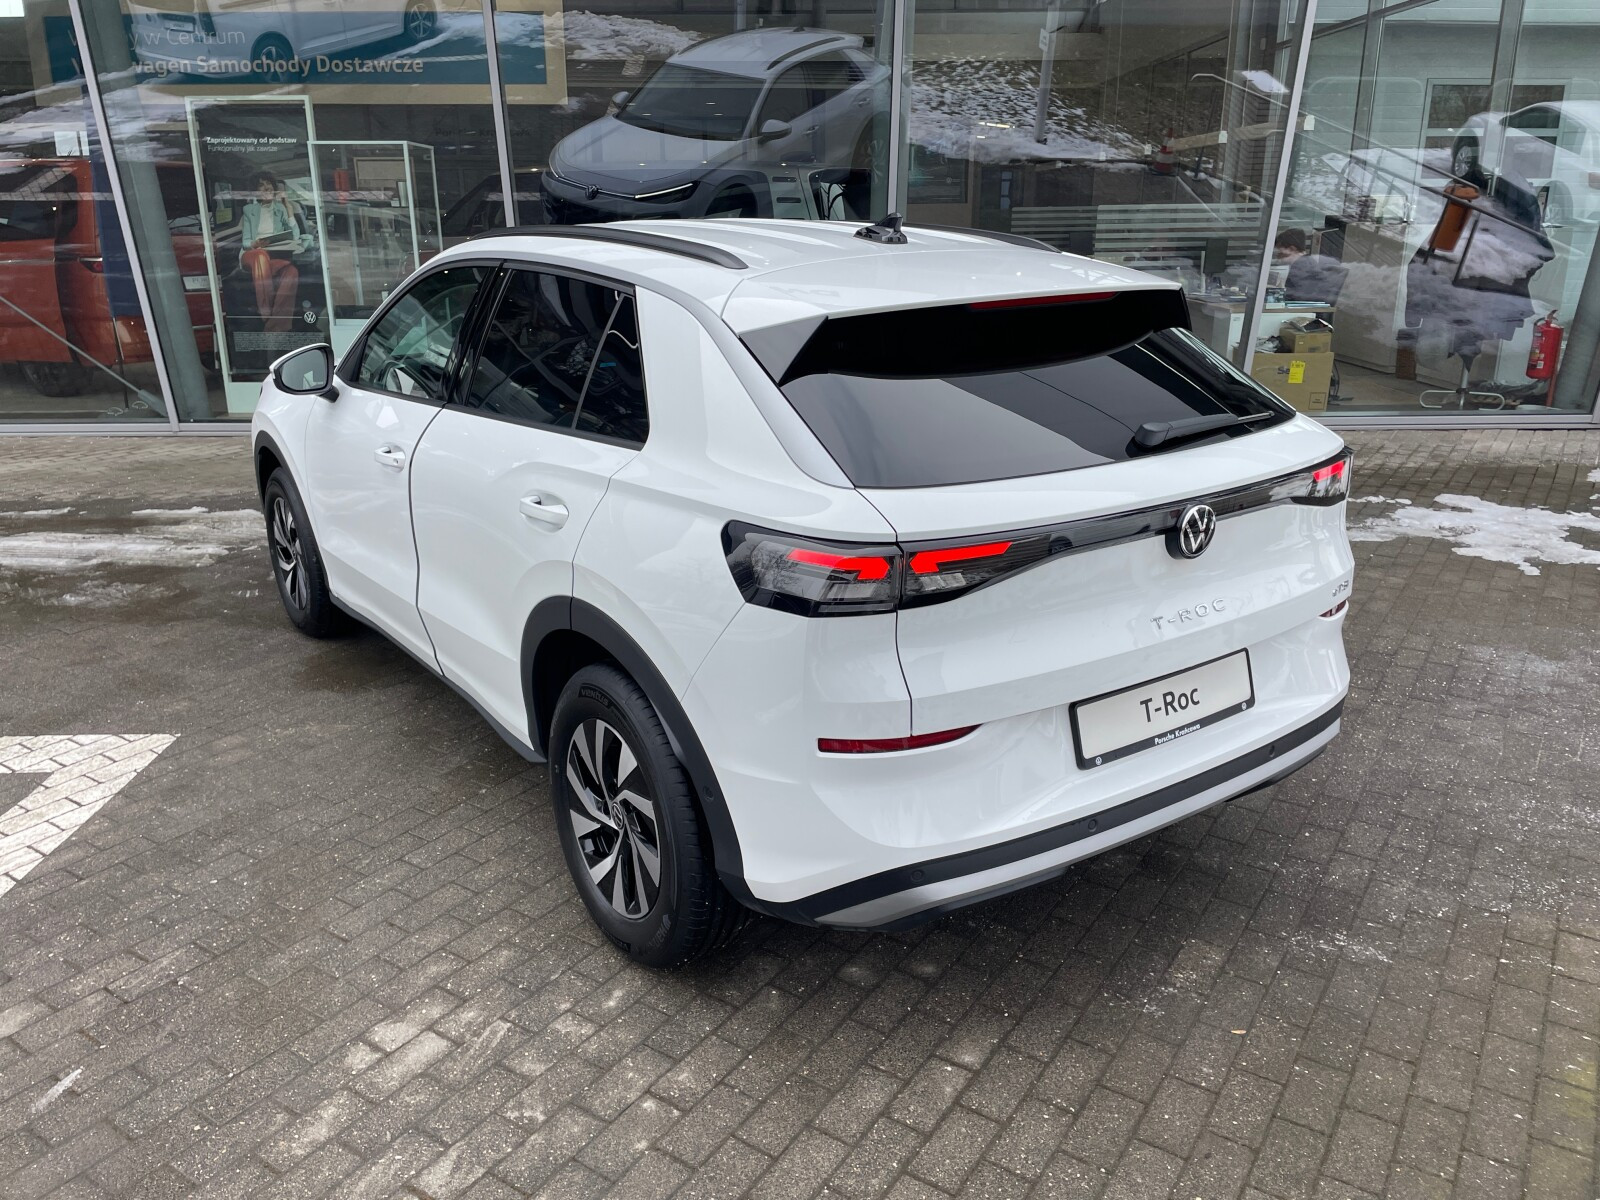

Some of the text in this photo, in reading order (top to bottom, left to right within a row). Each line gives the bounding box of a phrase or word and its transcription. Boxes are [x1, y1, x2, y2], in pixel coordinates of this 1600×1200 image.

[143, 32, 161, 46] w
[166, 29, 246, 46] Centrum
[196, 55, 311, 77] Samochody
[317, 55, 424, 73] Dostawcze
[206, 136, 258, 145] Zaprojektowany
[259, 136, 268, 144] od
[208, 145, 245, 153] Funkcjonalny
[247, 145, 255, 153] jak
[1150, 598, 1226, 630] T-ROC
[1139, 687, 1201, 723] T-Roc
[1155, 733, 1174, 744] Porsche
